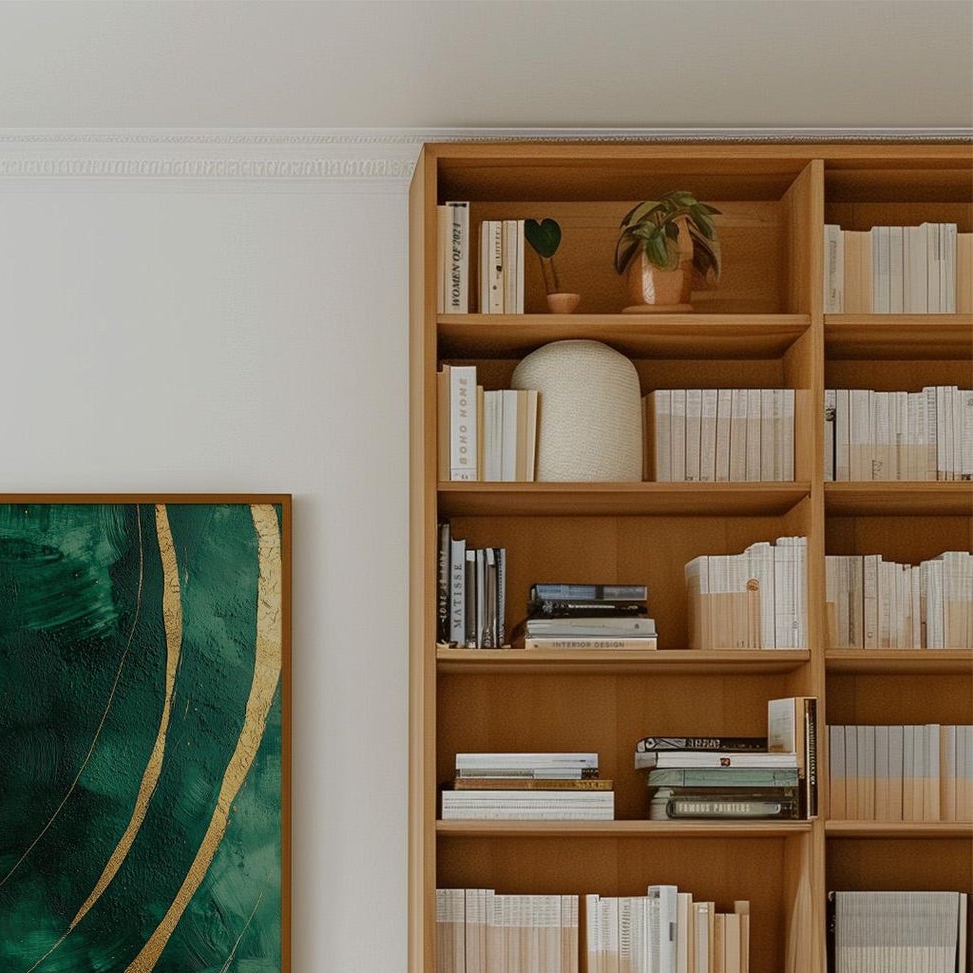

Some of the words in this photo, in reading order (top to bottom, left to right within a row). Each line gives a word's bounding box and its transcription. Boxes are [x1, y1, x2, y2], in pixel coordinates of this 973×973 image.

[451, 264, 461, 307] WOMEN
[459, 377, 468, 418] HOME
[459, 424, 468, 465] BOHO
[453, 562, 462, 629] MATISSE
[678, 803, 710, 812] FAMOUS
